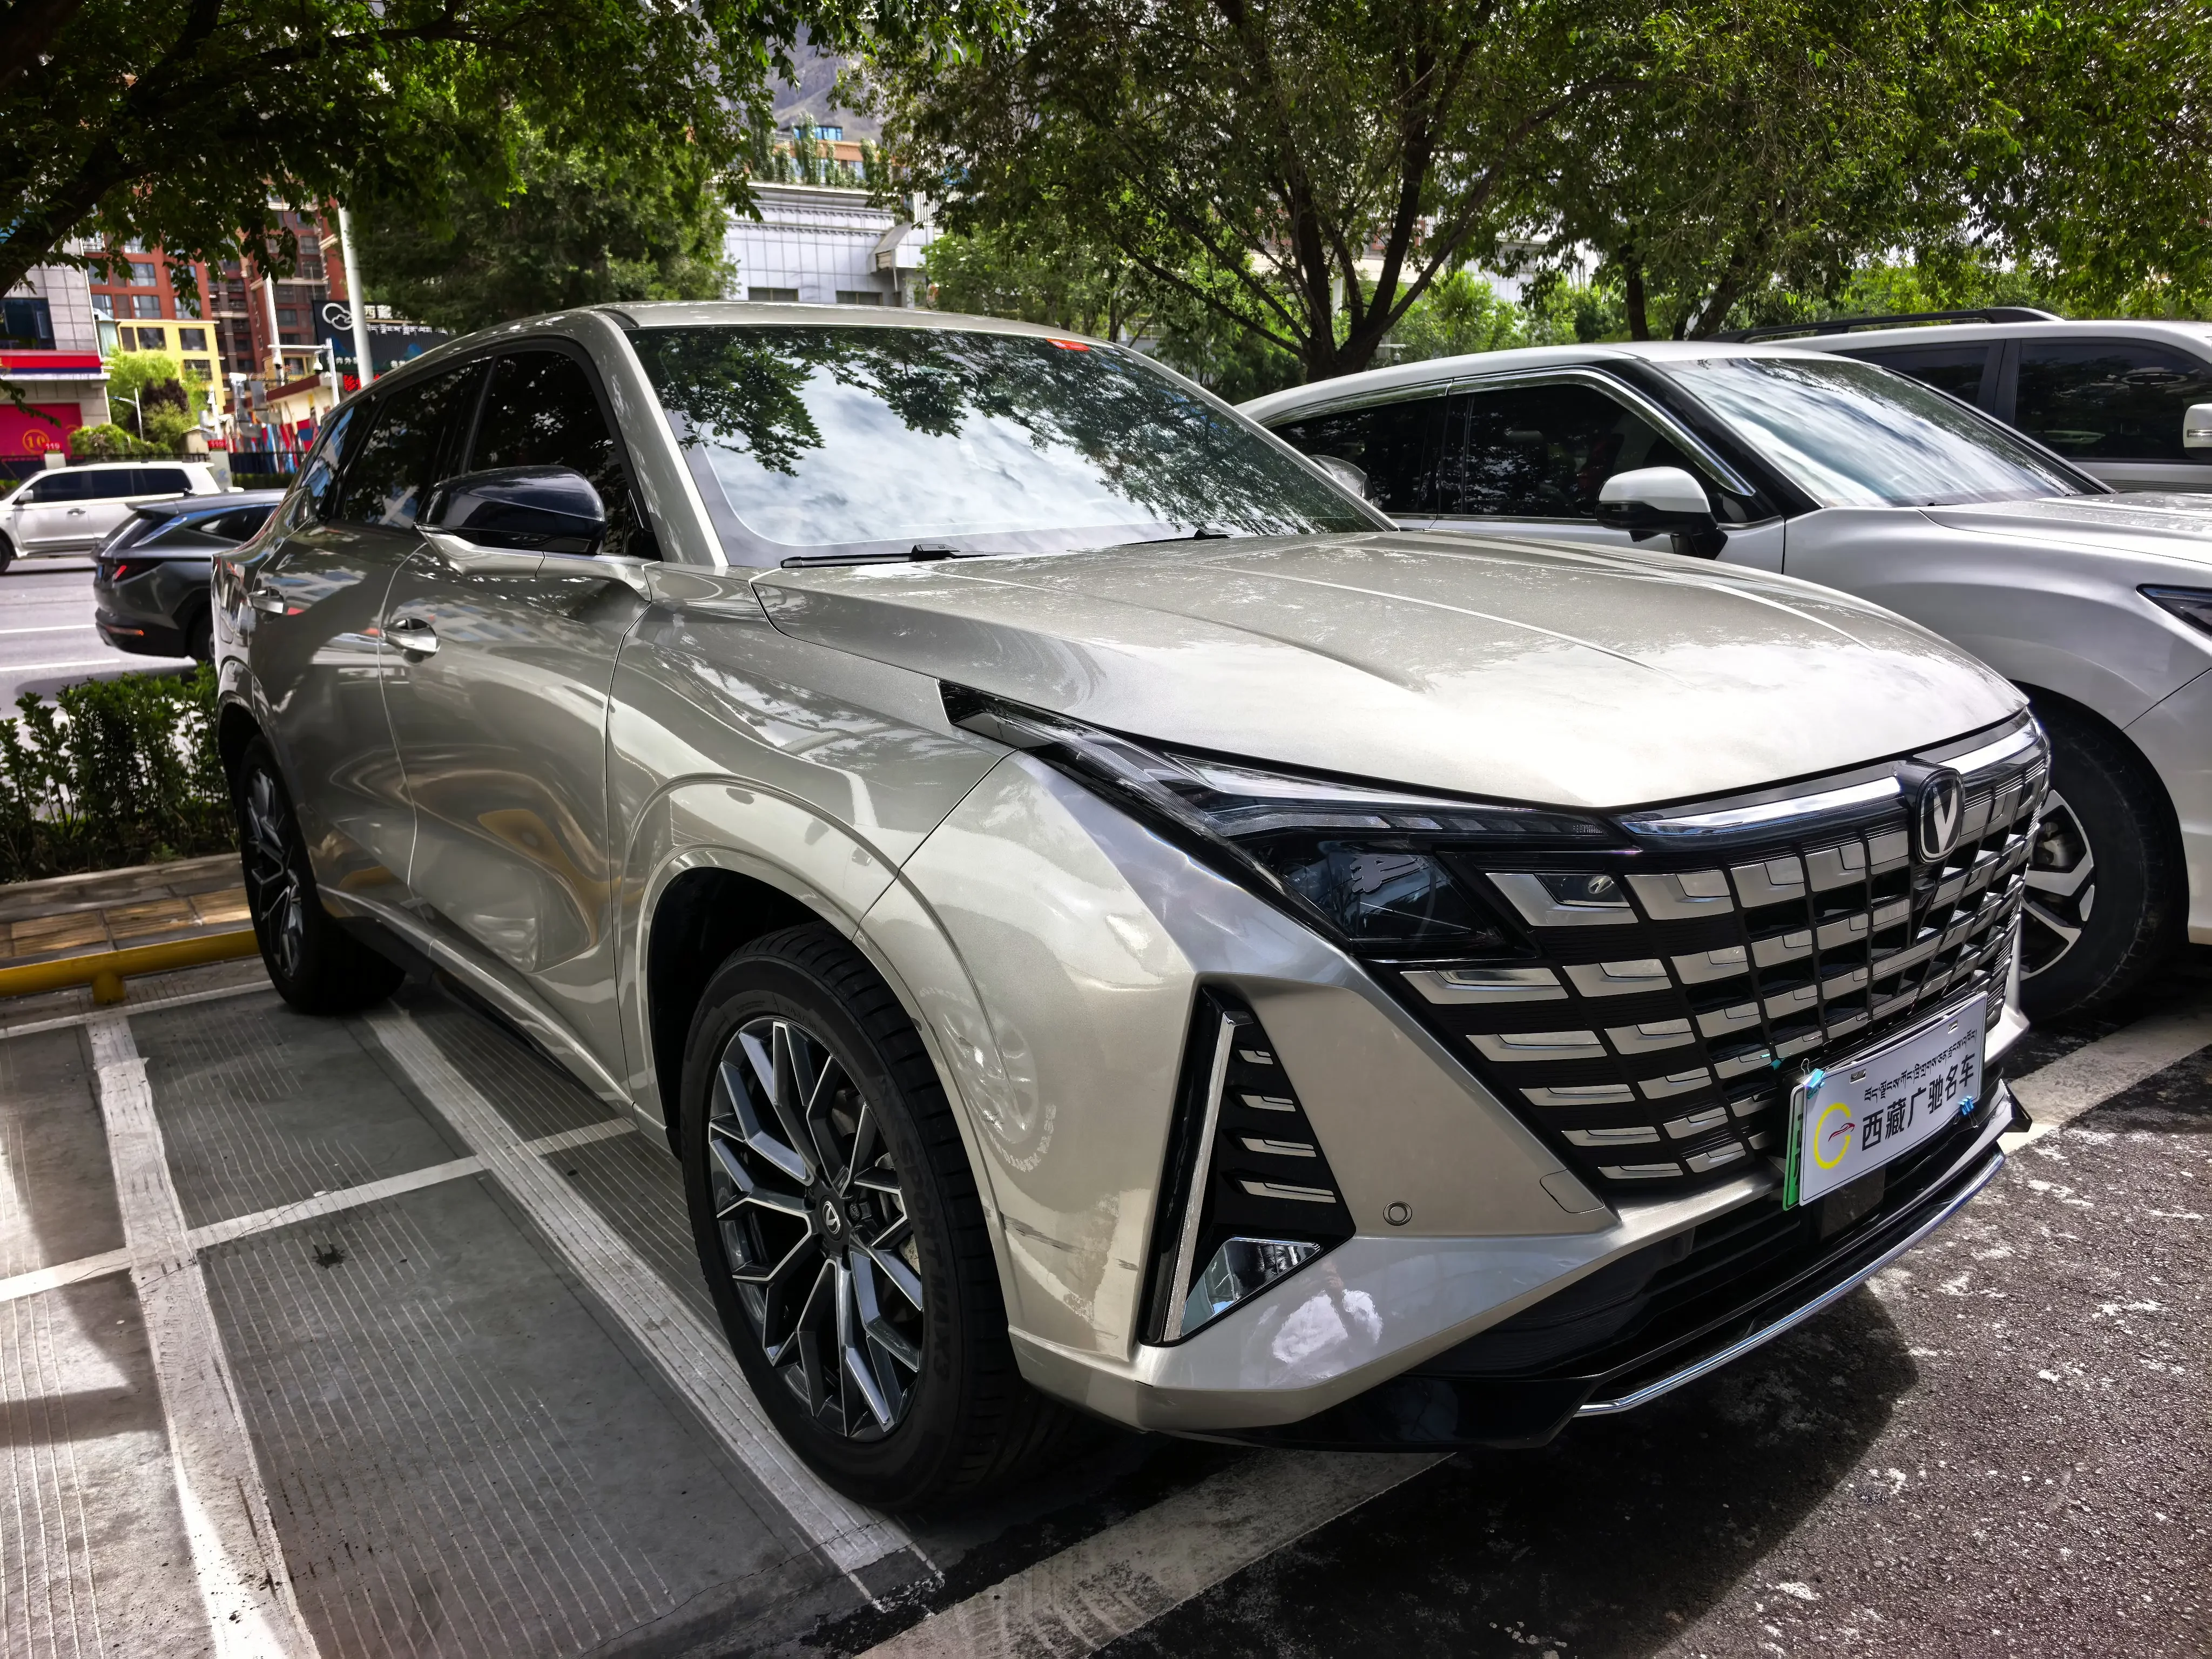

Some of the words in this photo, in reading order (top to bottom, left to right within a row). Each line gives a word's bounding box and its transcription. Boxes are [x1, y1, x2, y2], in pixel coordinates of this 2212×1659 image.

[1862, 1053, 1975, 1151] 西藏广驰名车
